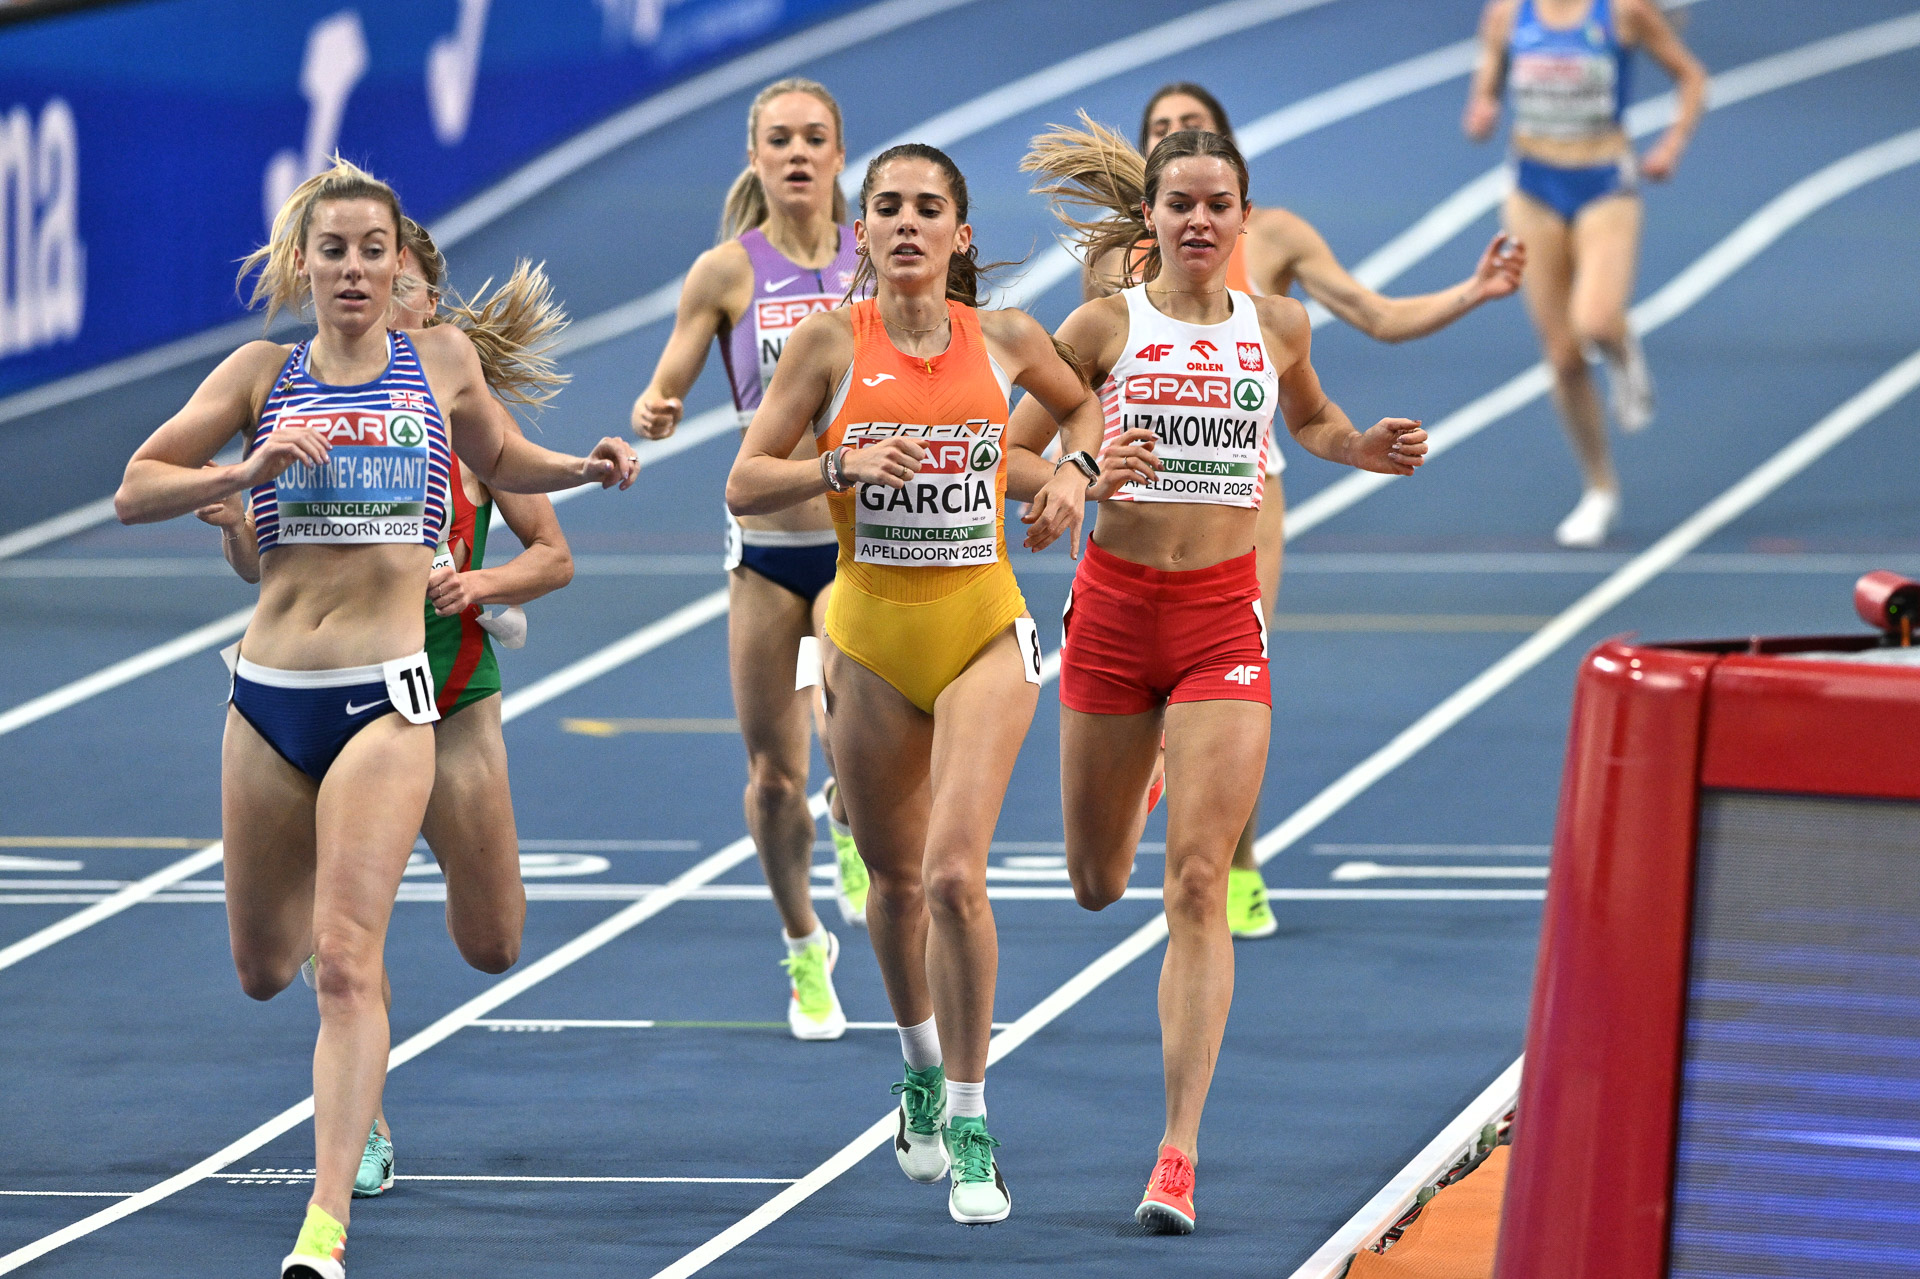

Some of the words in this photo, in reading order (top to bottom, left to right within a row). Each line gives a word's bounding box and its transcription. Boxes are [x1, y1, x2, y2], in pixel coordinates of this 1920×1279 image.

[761, 301, 845, 326] SPA
[1135, 343, 1175, 362] 4F
[1186, 362, 1224, 372] ORLEN
[1127, 377, 1229, 404] SPAR
[860, 473, 992, 514] GARCÍA
[1223, 482, 1254, 496] 2025
[312, 504, 341, 515] RUN
[284, 522, 381, 537] APELDOORN
[384, 522, 419, 536] 2025
[885, 527, 889, 538] I
[891, 528, 922, 539] RUN
[860, 543, 959, 560] APELDOORN
[961, 543, 993, 559] 2025
[1224, 664, 1262, 685] 4F
[399, 665, 431, 715] 11
